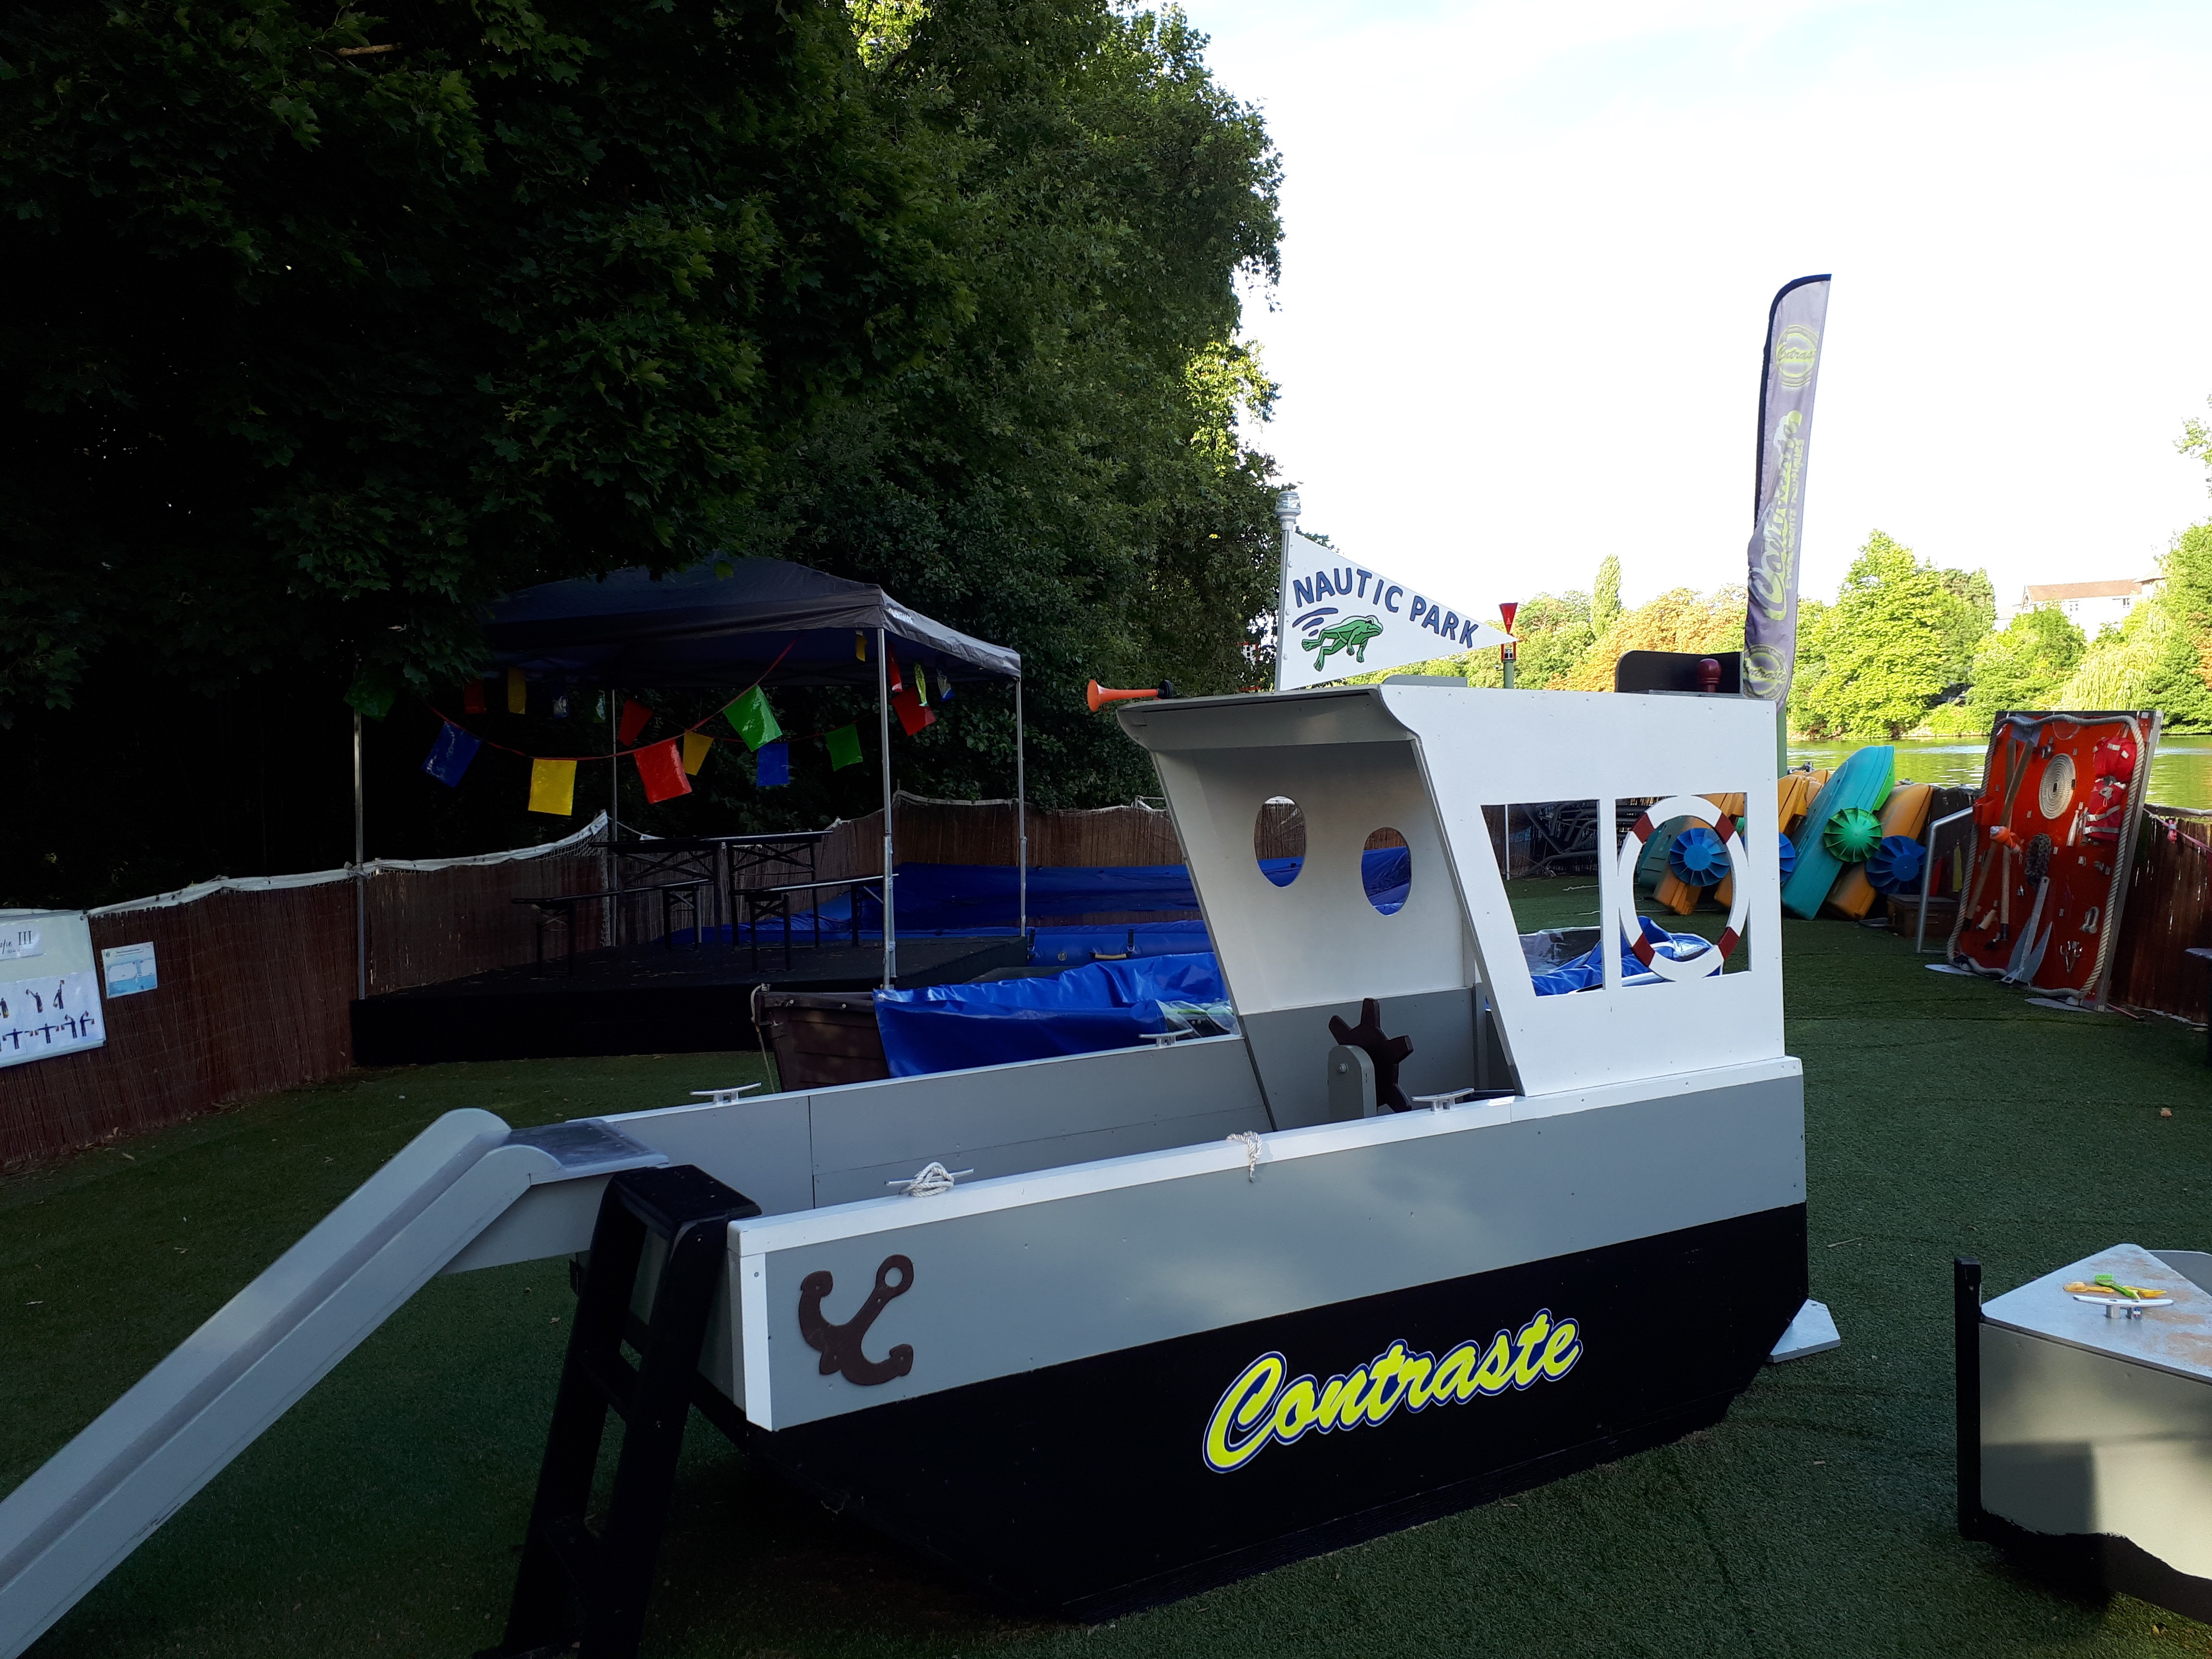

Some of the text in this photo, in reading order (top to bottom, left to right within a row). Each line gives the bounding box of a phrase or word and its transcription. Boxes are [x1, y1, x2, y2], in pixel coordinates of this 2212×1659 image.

[1293, 567, 1479, 649] NAUTIC PARK
[1204, 1310, 1581, 1470] Contraste
